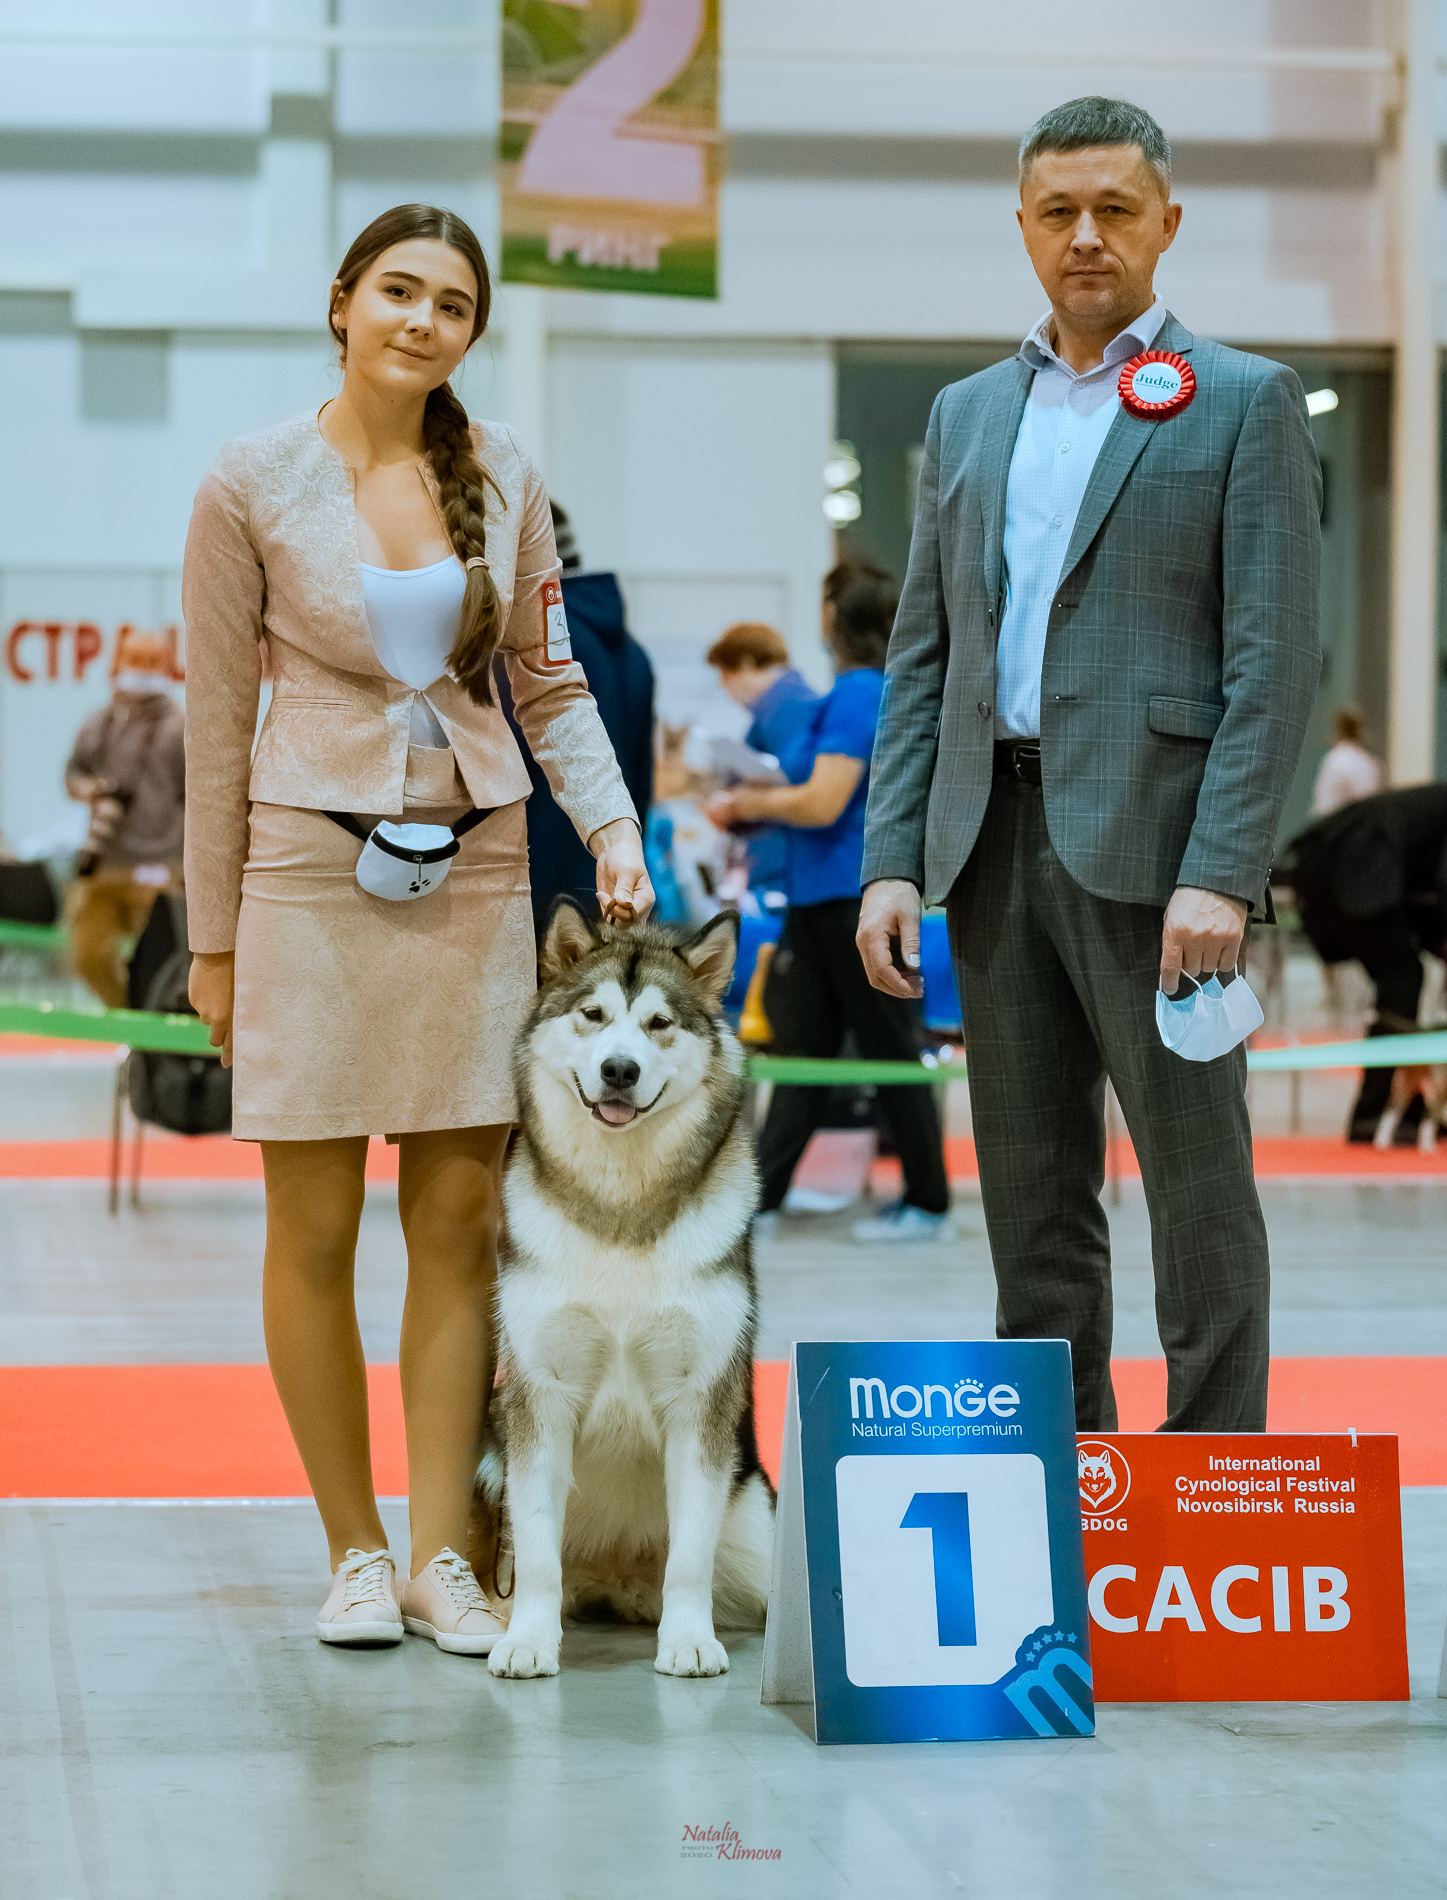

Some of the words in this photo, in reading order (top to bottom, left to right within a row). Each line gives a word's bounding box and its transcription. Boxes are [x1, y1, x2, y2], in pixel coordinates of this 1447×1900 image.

[517, 0, 706, 207] 2
[1135, 373, 1179, 390] Judge
[852, 1422, 907, 1437] Natural
[911, 1421, 1023, 1439] Superpremium
[1208, 1455, 1321, 1471] International
[1175, 1476, 1281, 1495] Cynological
[1286, 1477, 1356, 1493] Festival
[1177, 1497, 1284, 1514] Novosibirsk
[1294, 1498, 1355, 1514] Russia
[899, 1492, 977, 1646] 1
[1087, 1564, 1351, 1633] CACIB
